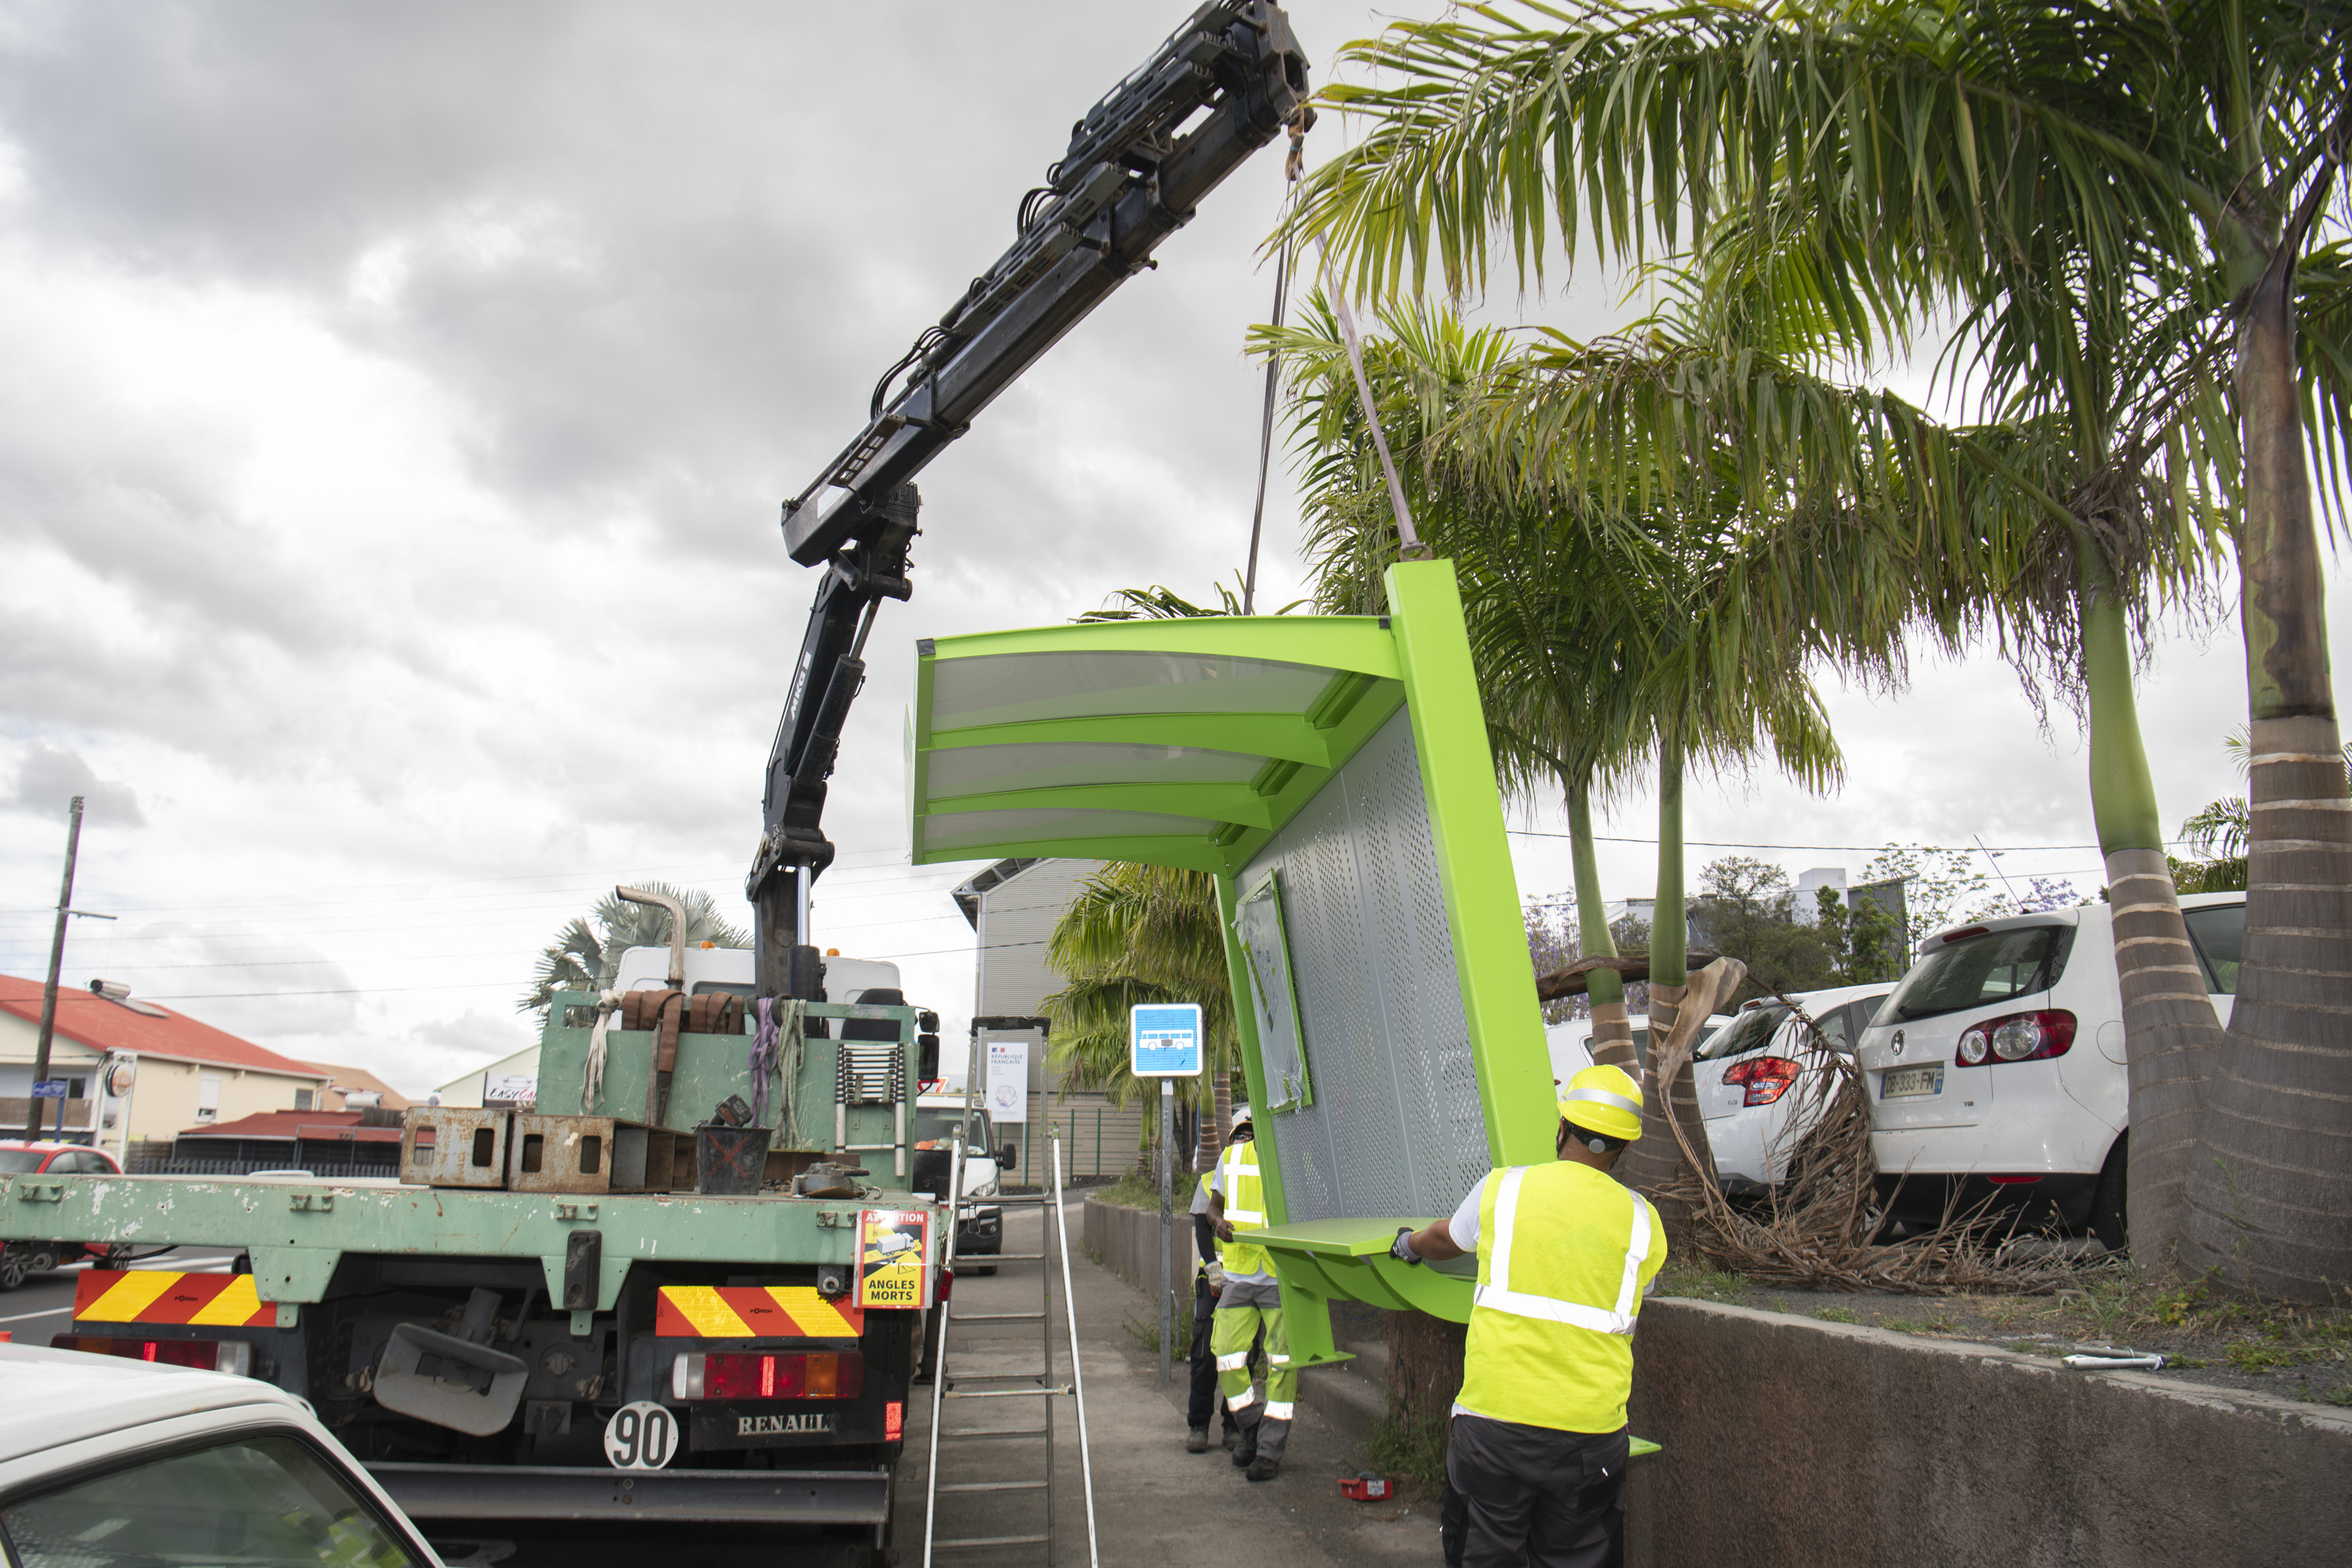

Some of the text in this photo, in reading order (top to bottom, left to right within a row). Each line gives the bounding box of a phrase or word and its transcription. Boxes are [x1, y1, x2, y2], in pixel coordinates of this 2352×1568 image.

[791, 671, 806, 721] MKG
[869, 1280, 915, 1289] ANGLES
[871, 1291, 913, 1300] MORTS
[613, 1409, 668, 1467] 90
